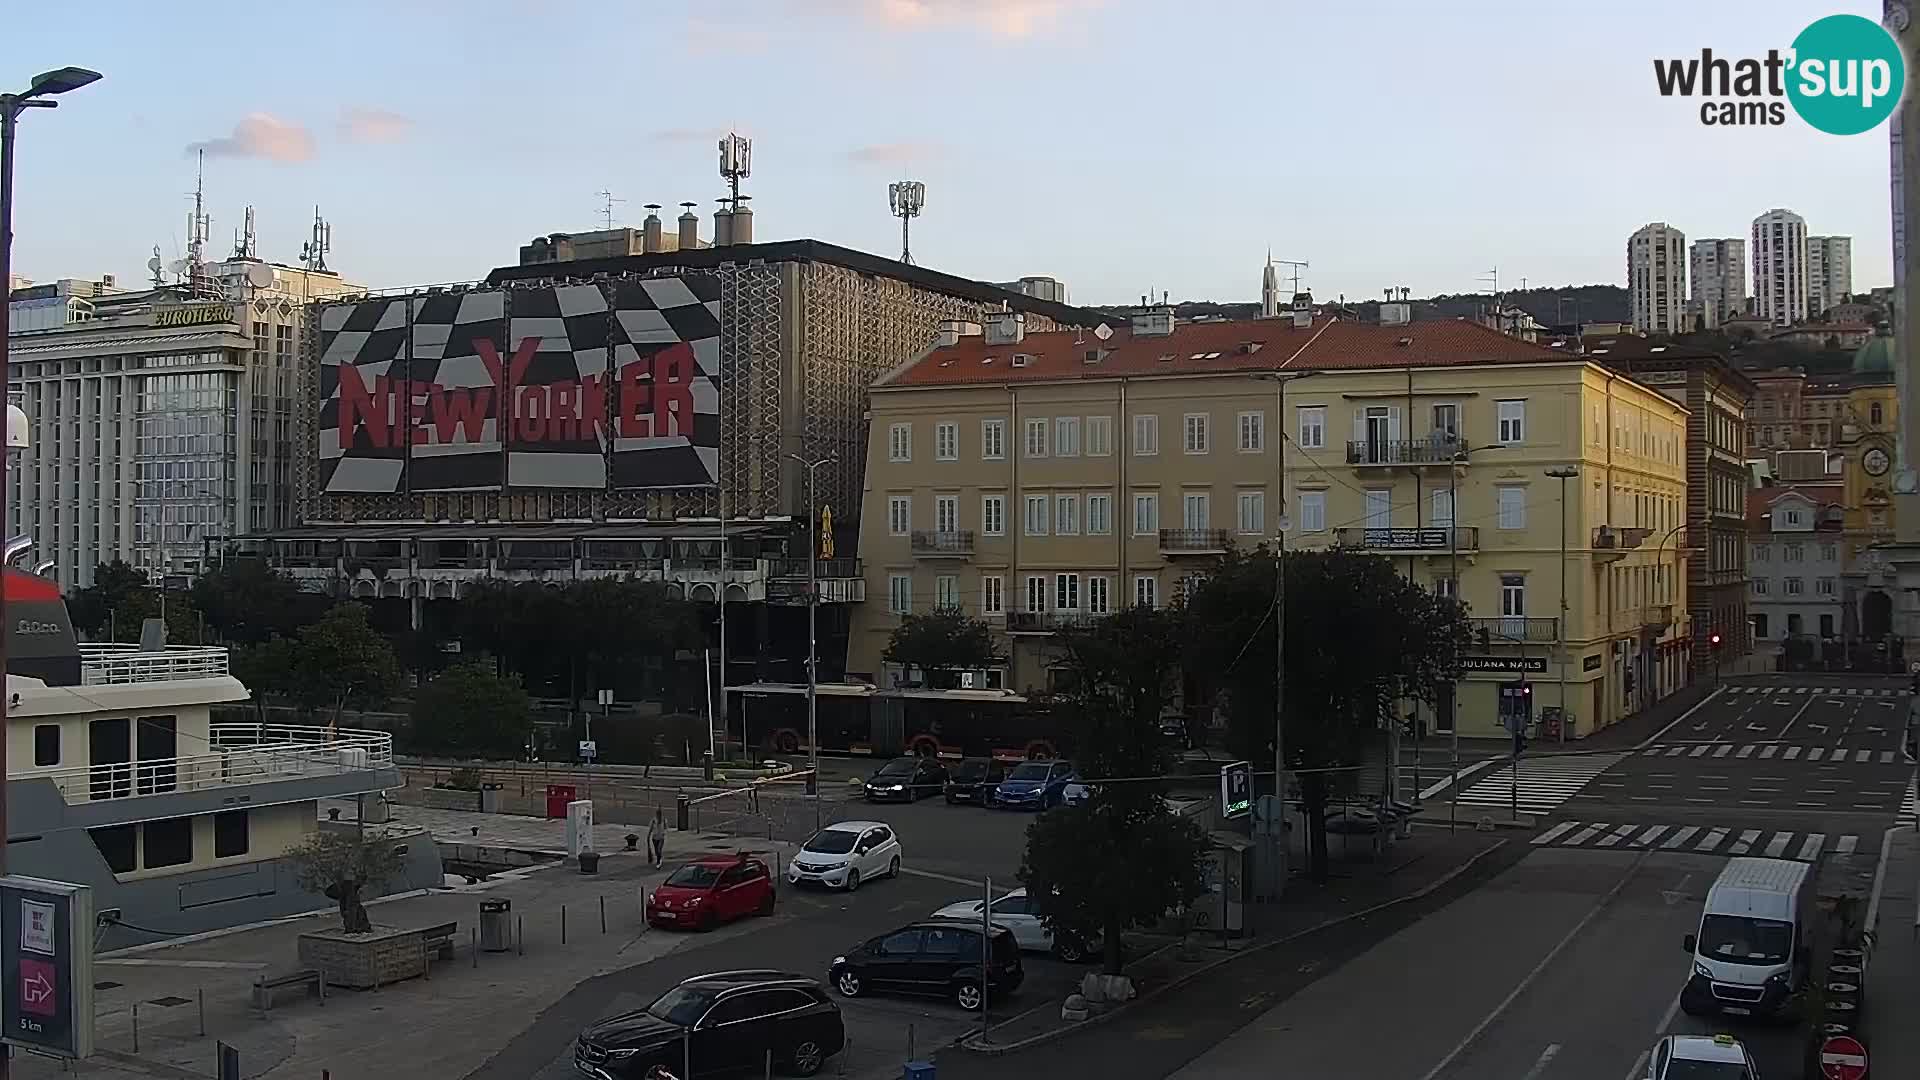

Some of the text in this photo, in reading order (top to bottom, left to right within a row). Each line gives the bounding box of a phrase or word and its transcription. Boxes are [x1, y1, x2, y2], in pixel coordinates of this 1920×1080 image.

[1460, 660, 1541, 669] JULIANA NAILS
[20, 1018, 42, 1032] 5 km
